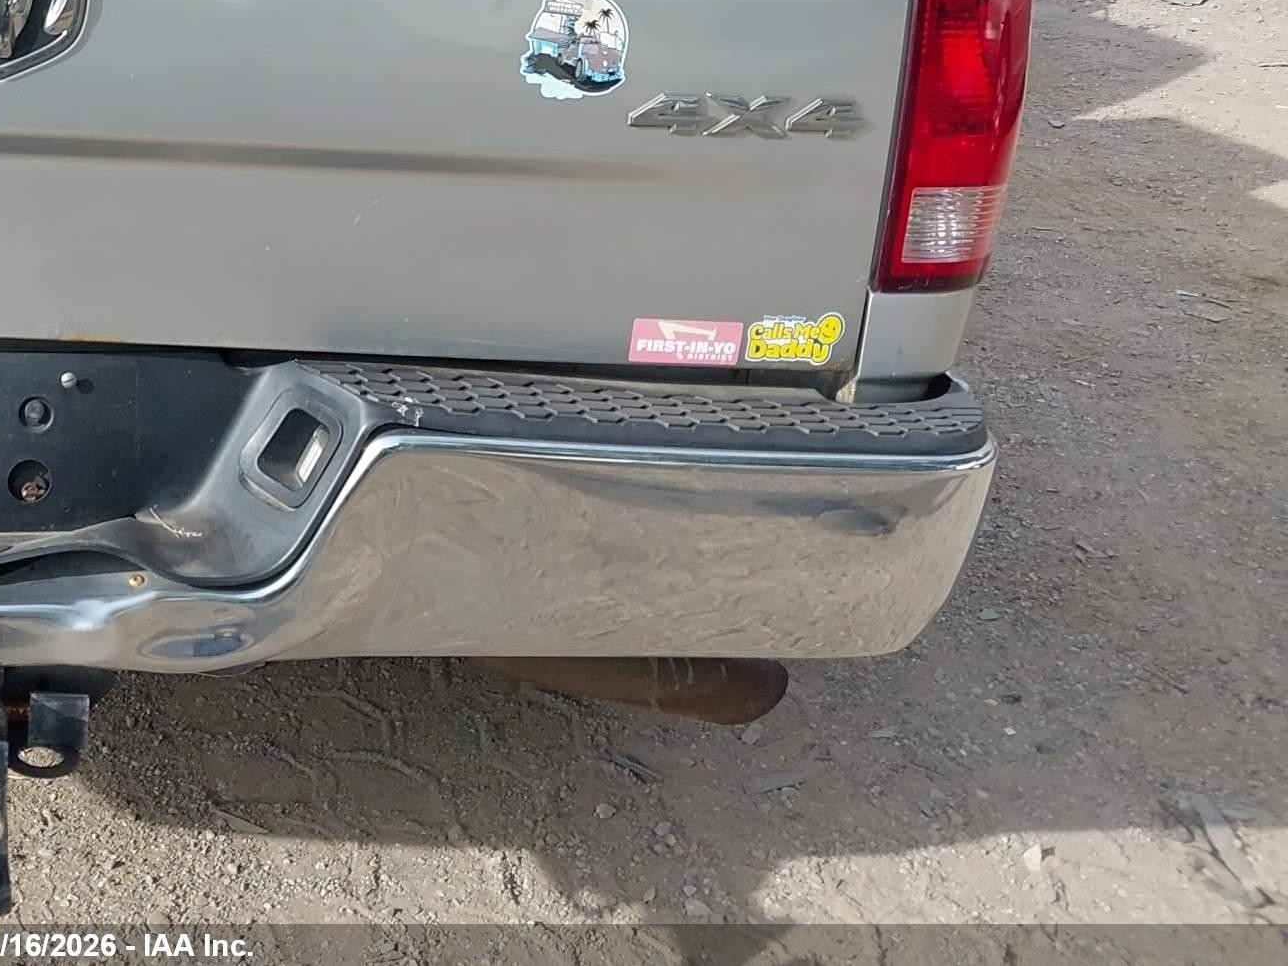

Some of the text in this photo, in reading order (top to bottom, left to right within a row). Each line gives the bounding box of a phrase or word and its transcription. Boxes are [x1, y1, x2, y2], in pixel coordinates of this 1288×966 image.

[750, 322, 821, 340] Calls Me
[636, 338, 737, 355] FIRST-IN-YO
[748, 338, 830, 363] Daddy
